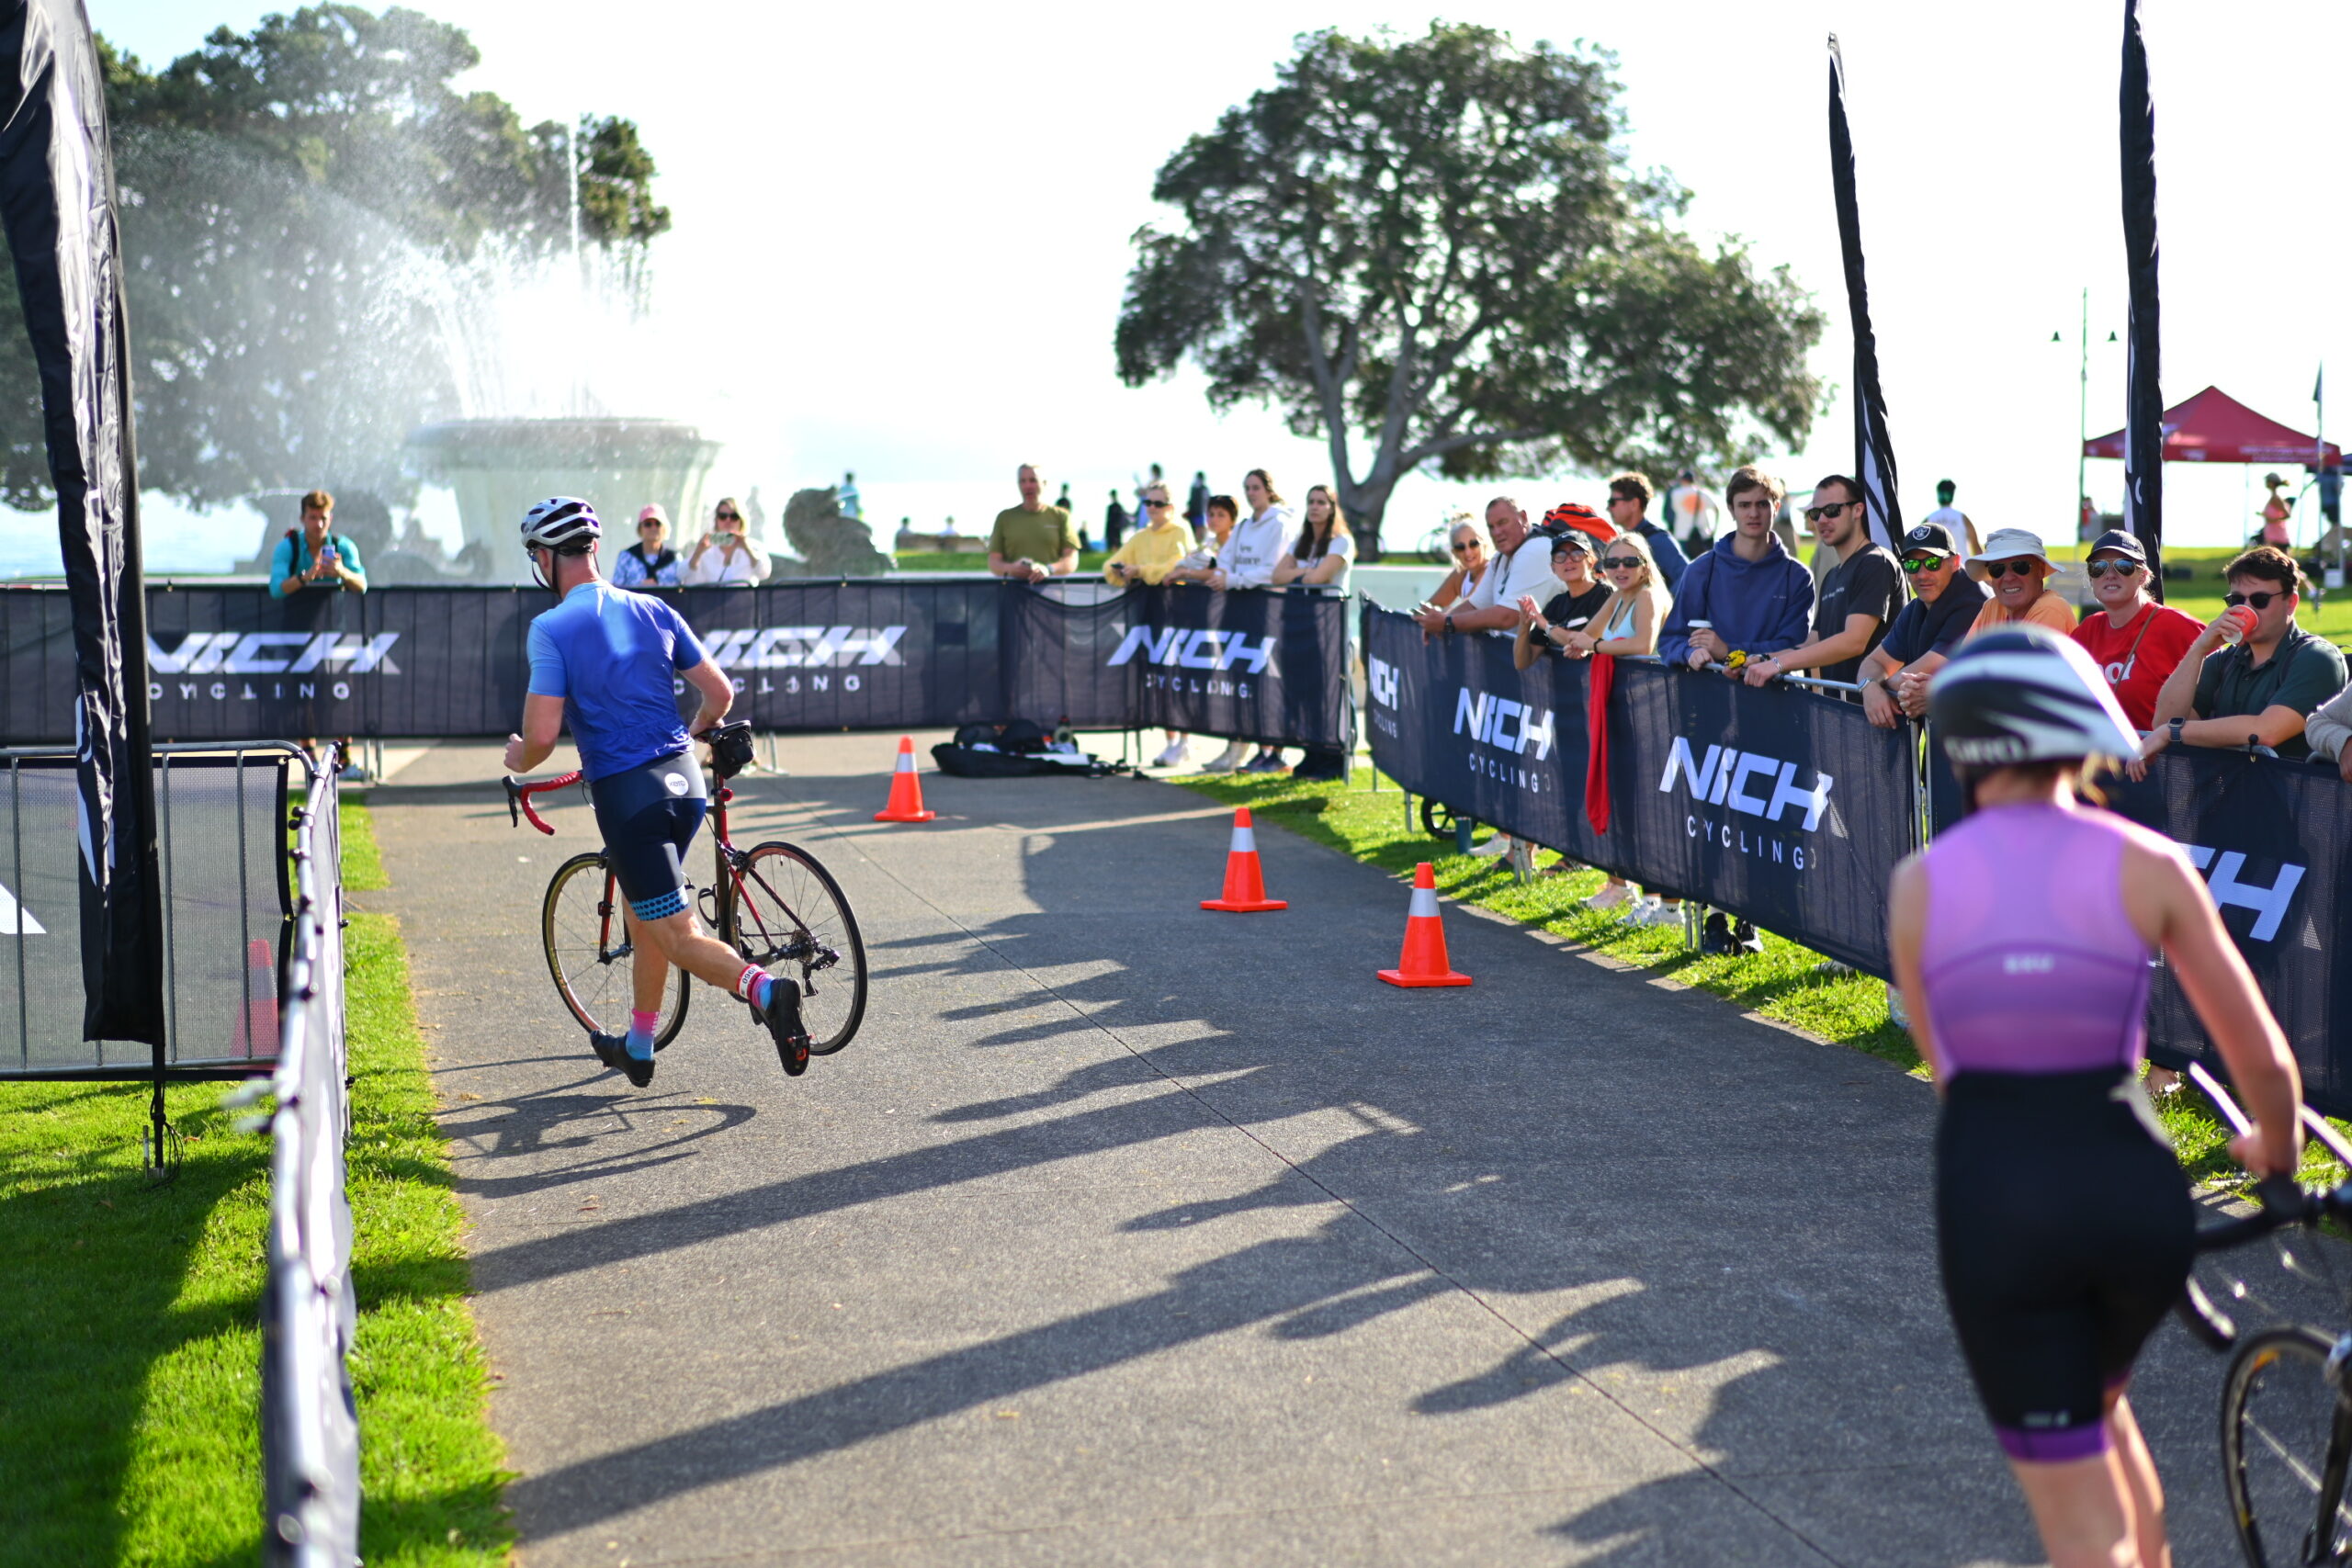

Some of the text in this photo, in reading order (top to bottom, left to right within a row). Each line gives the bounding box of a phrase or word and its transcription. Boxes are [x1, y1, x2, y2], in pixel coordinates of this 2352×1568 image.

[1106, 625, 1277, 674] NICH
[1453, 687, 1555, 761] NICH
[1469, 752, 1539, 794] CYCLING
[1658, 735, 1834, 832] NICH
[1687, 815, 1804, 870] CYCLING
